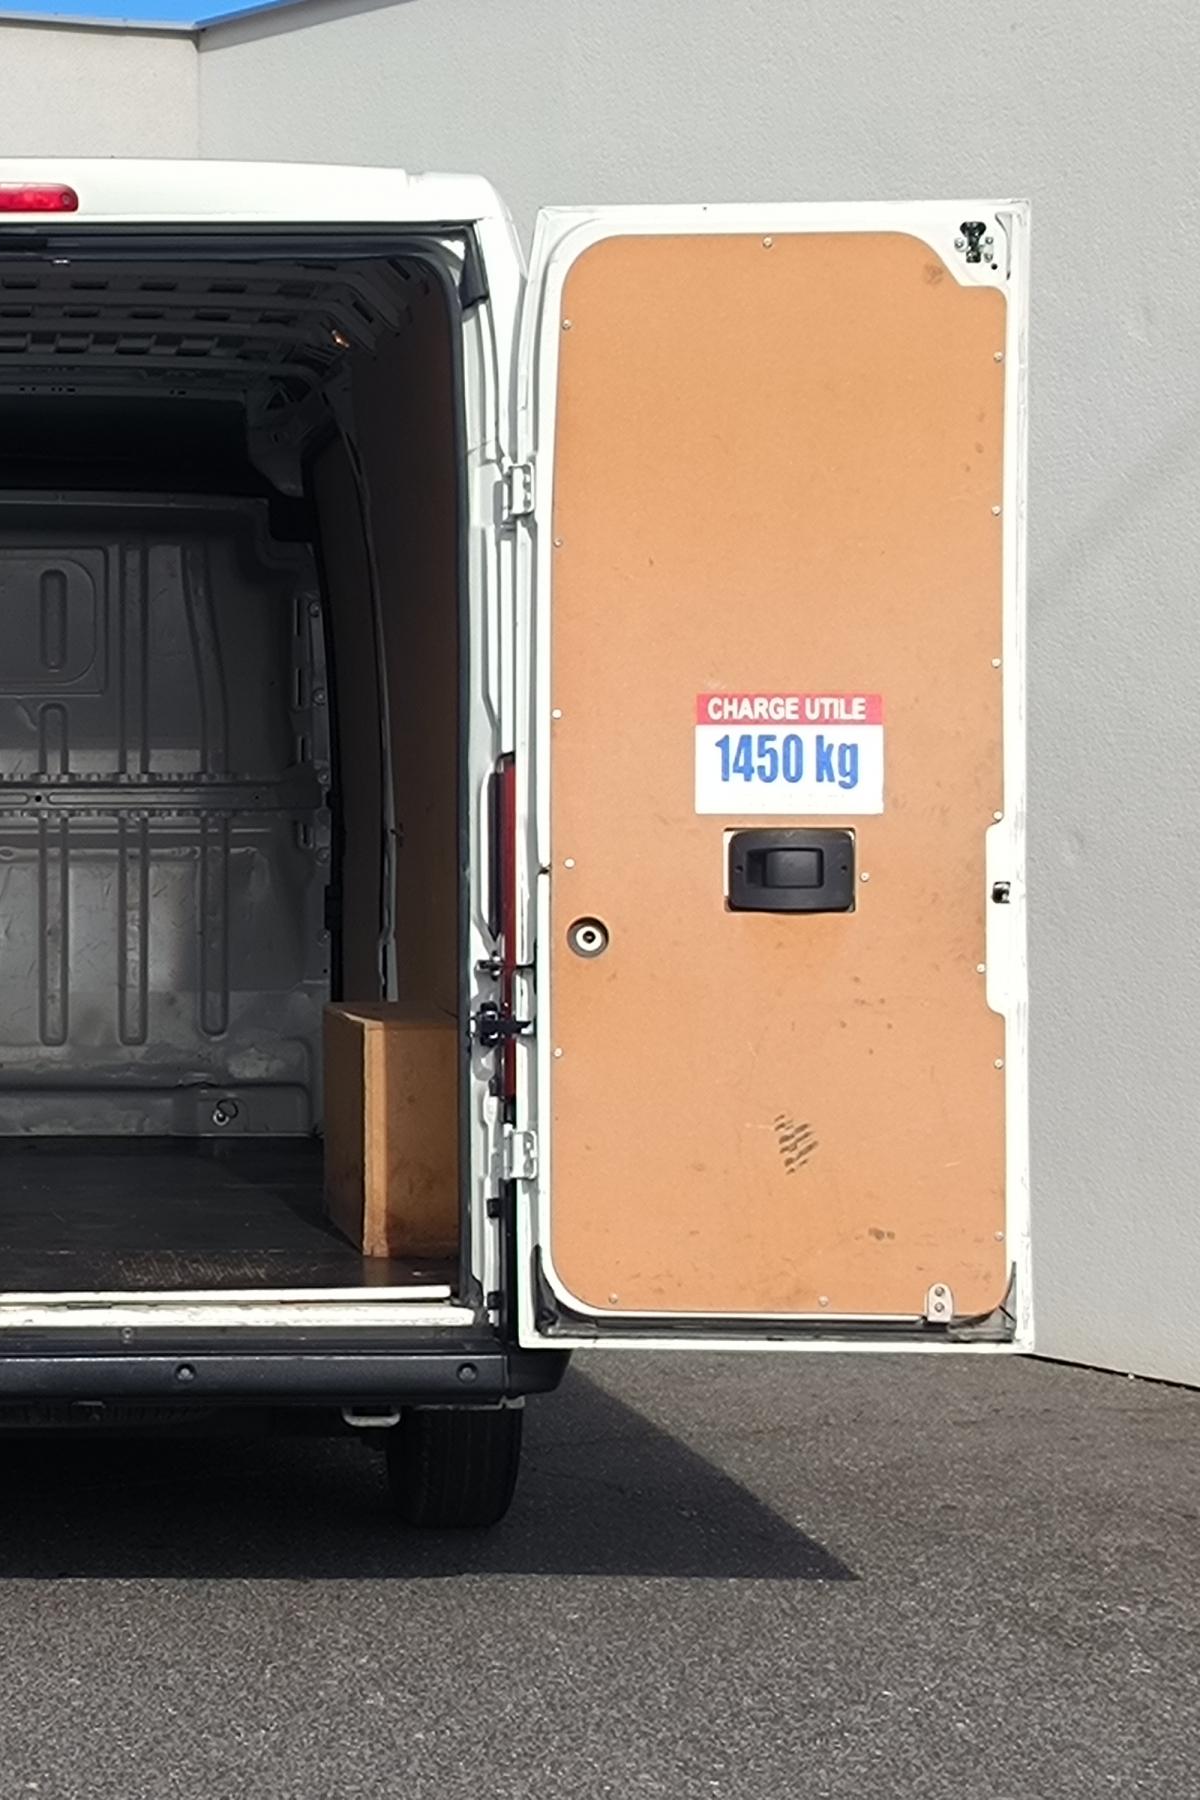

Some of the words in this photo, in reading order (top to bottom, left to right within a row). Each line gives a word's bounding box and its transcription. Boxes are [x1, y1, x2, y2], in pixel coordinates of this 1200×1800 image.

[707, 696, 800, 720] CHARGE
[805, 696, 867, 720] UTILE
[715, 734, 804, 783] 1450
[815, 734, 859, 789] kg
